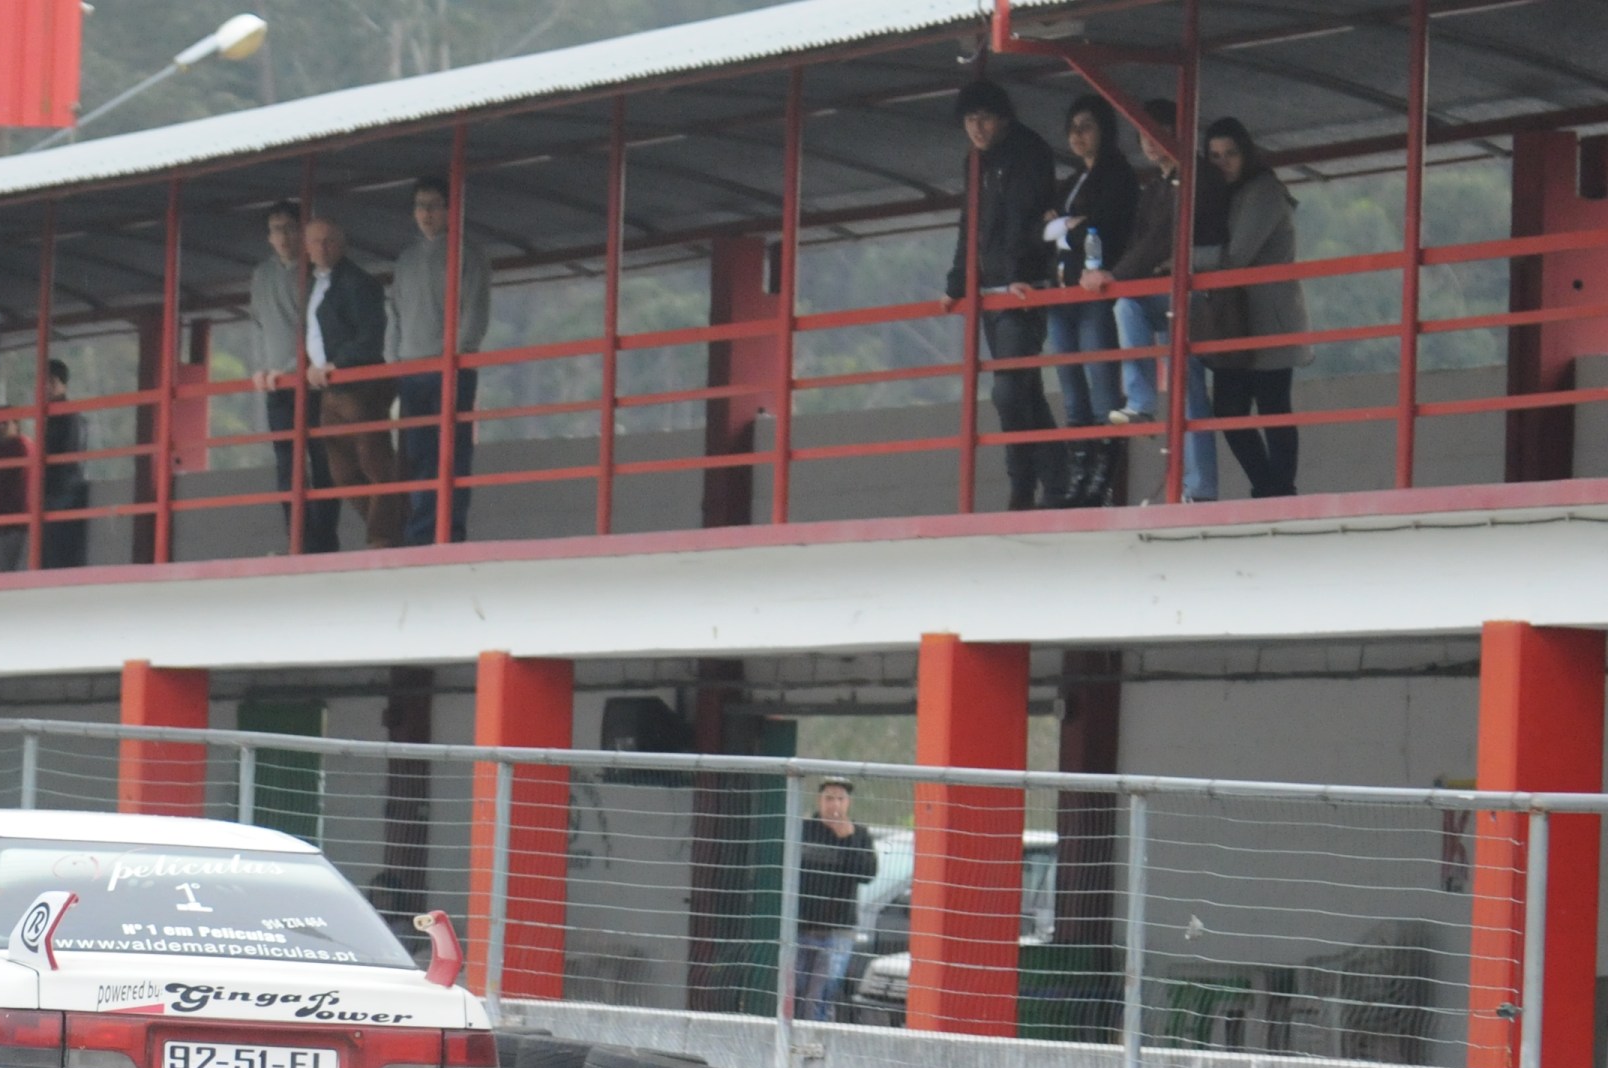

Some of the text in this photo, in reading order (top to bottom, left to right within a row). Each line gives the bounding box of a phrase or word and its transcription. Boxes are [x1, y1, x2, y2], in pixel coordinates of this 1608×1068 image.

[146, 924, 158, 935] 1
[163, 925, 193, 937] em
[55, 938, 358, 963] www.valdemarpeliculas.pt
[97, 980, 145, 1012] powered
[164, 982, 413, 1023] Ginga Power
